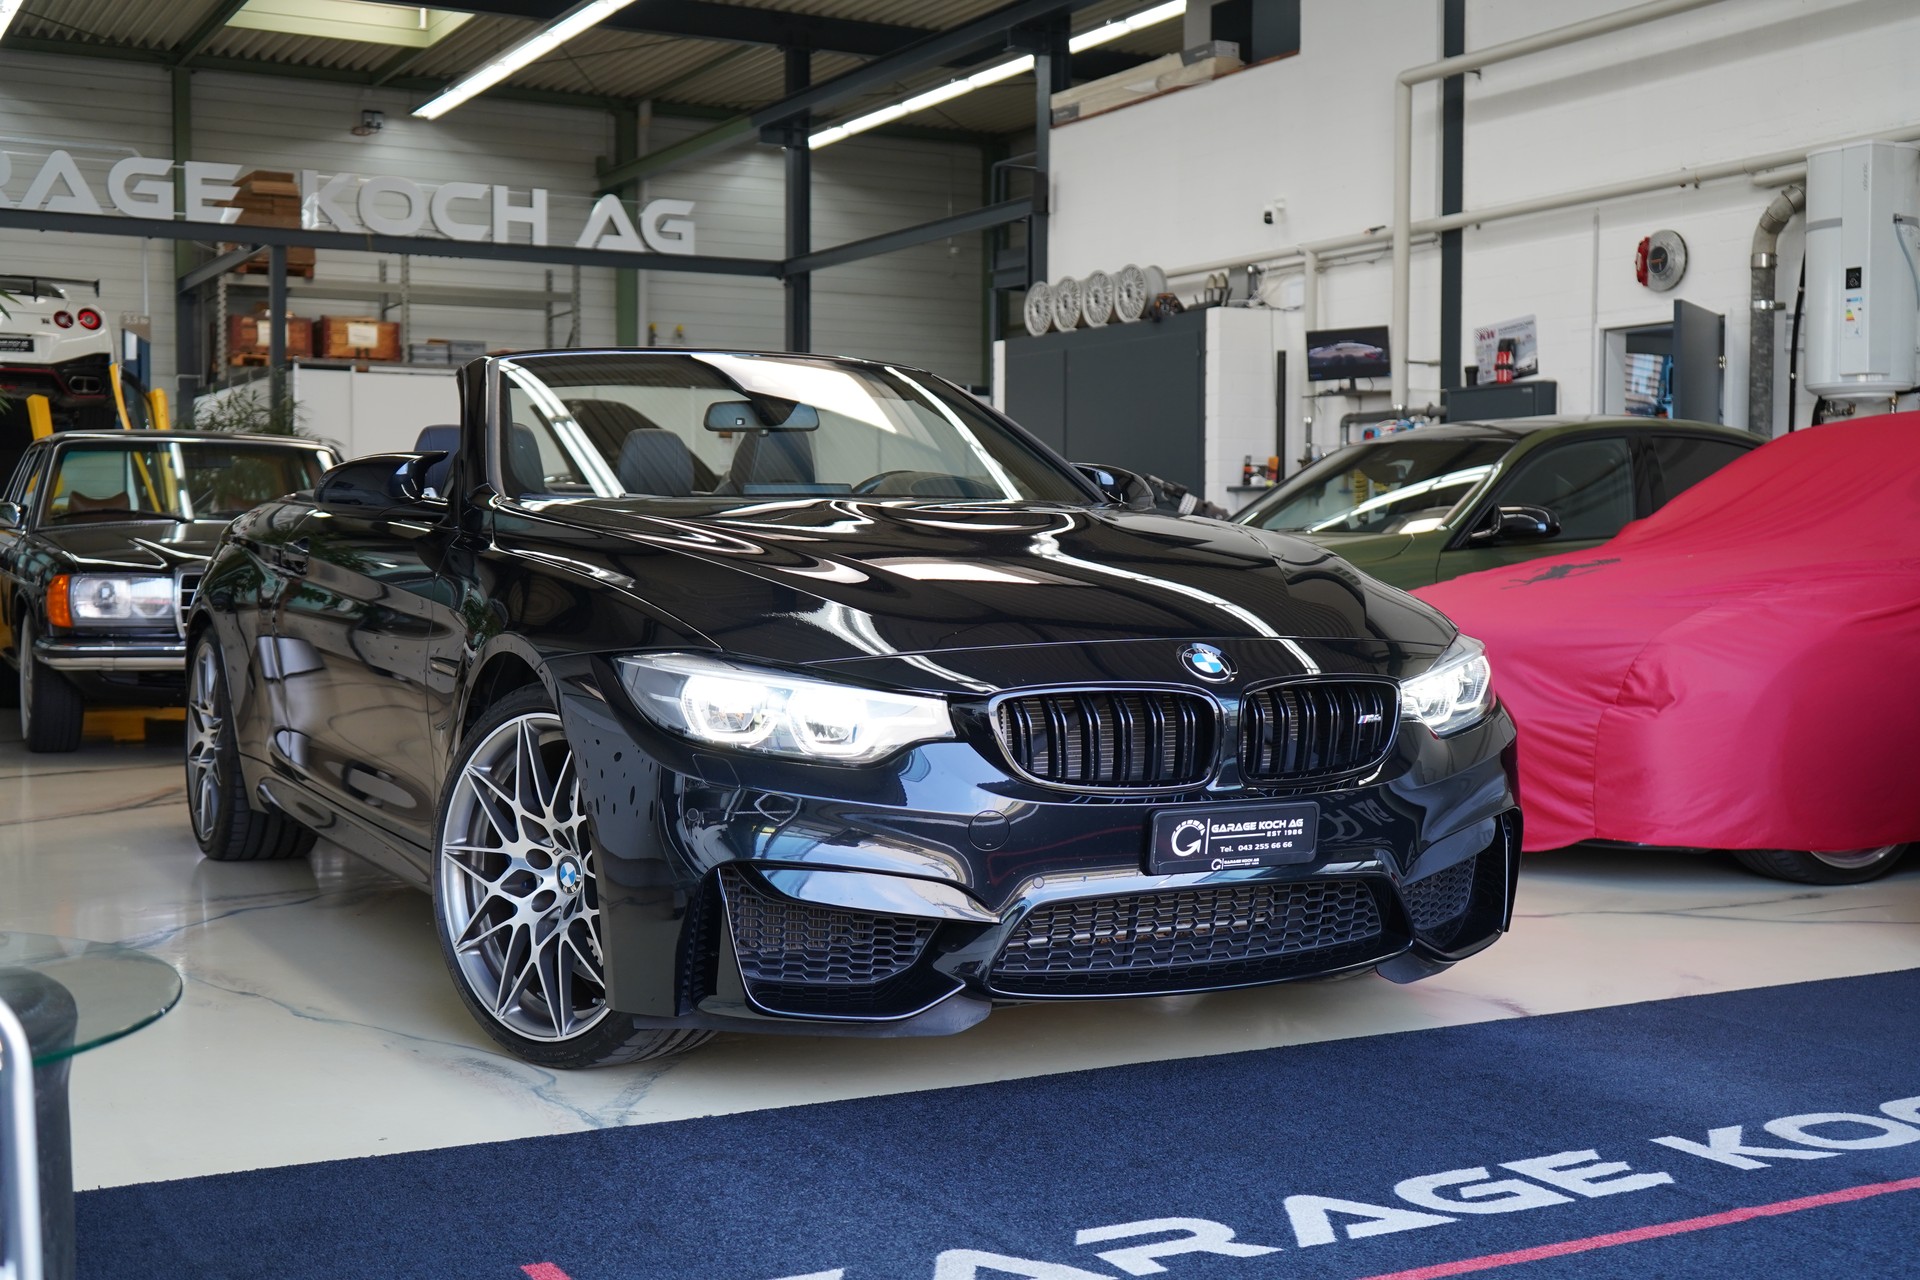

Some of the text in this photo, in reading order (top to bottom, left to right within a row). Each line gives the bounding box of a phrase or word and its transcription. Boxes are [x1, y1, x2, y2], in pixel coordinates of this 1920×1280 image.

[0, 149, 697, 255] AGE KOCH AG
[1211, 818, 1304, 834] GARAGE KOCH AG
[1266, 828, 1303, 838] EST 1986
[1220, 840, 1293, 854] Tel. 043 255 66 66
[770, 1149, 1675, 1280] ARAGE
